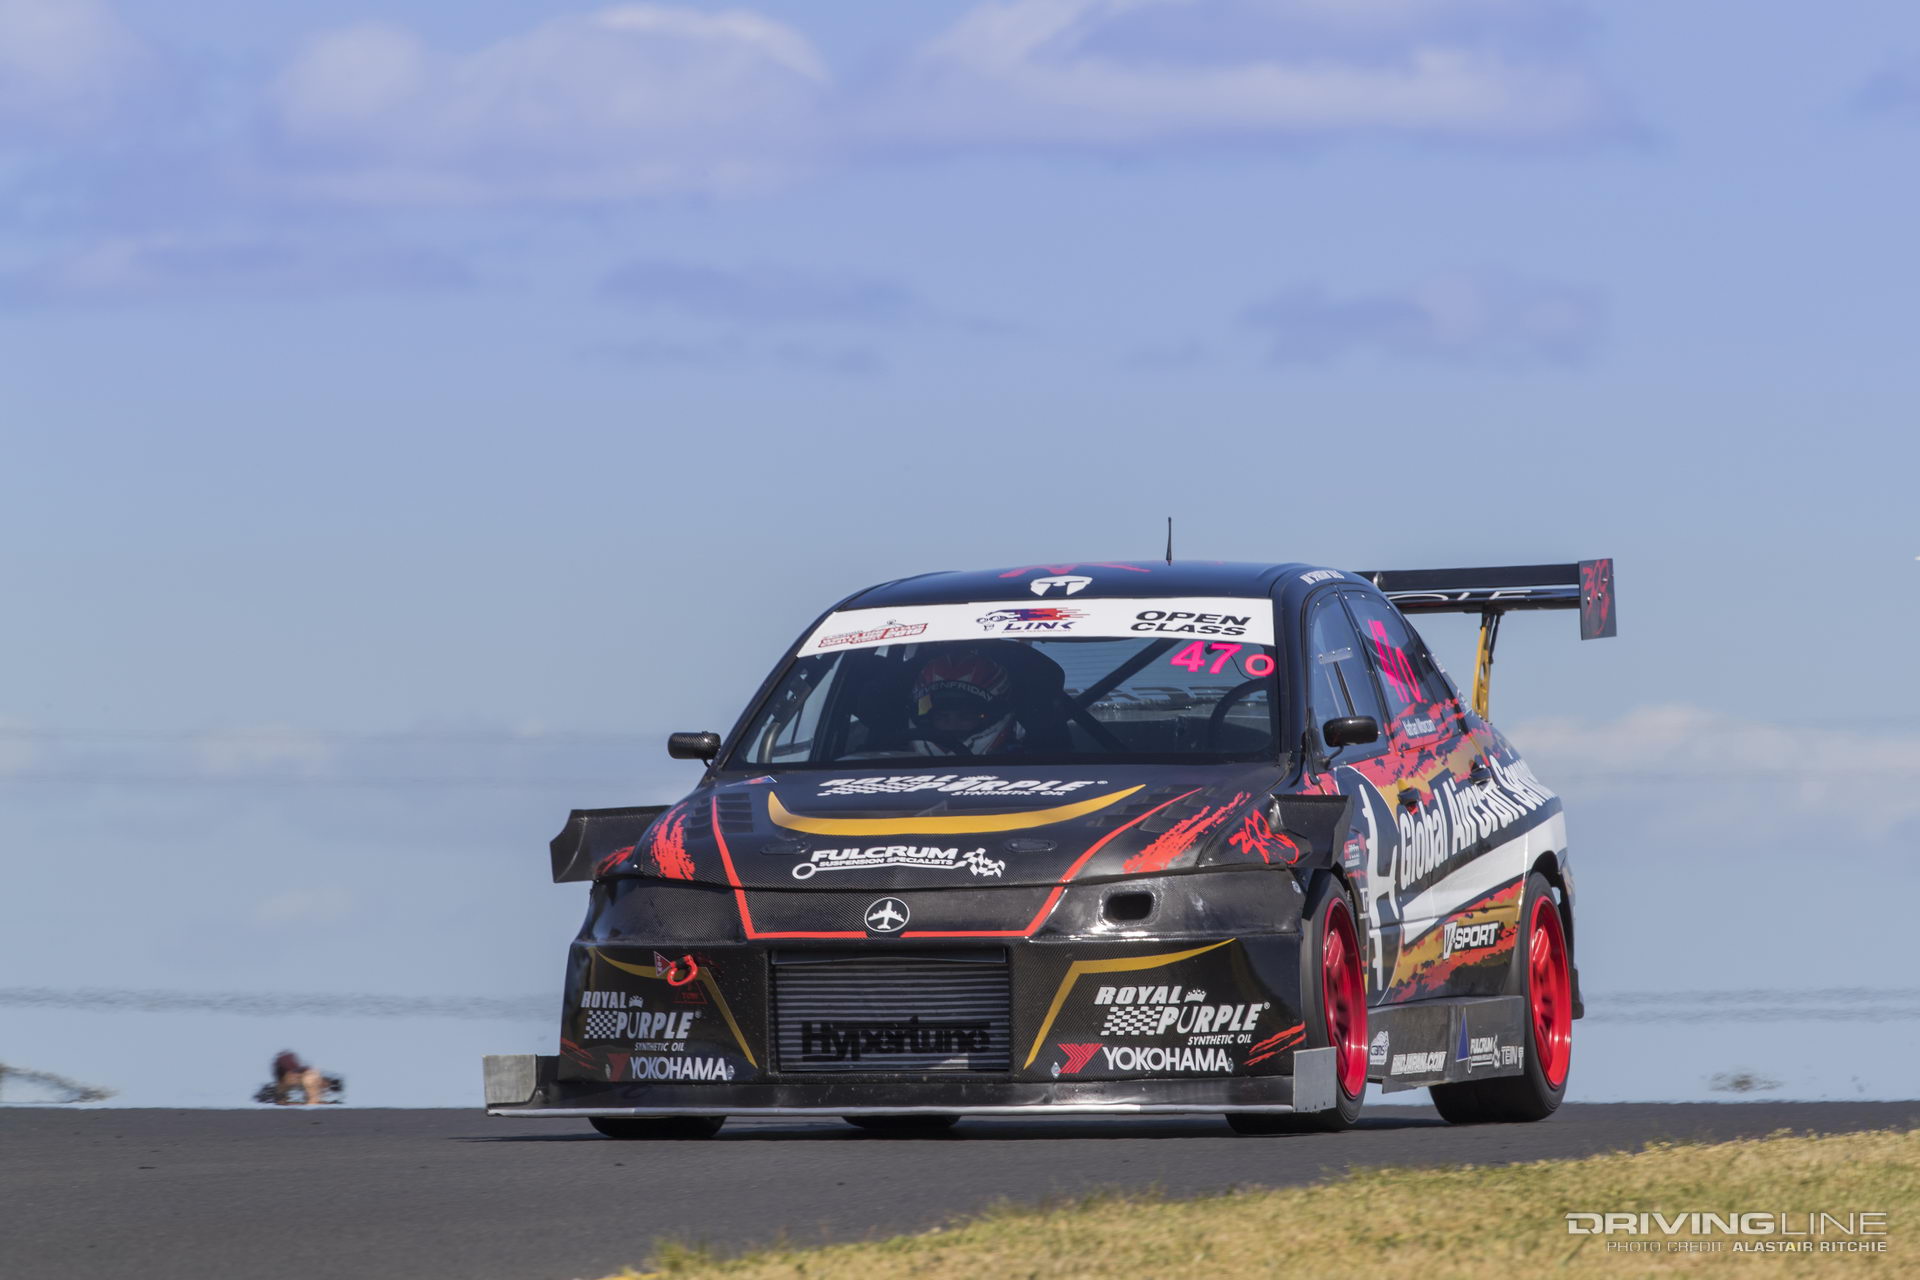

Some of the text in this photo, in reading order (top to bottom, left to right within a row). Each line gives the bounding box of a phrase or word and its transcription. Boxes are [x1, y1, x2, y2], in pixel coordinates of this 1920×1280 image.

[1004, 621, 1076, 631] LINK
[1136, 611, 1251, 626] OPEN
[1131, 622, 1246, 636] CLASS
[1170, 640, 1243, 675] 47
[819, 775, 958, 787] ROYAL
[903, 780, 1095, 793] PURPLE
[1399, 788, 1449, 891] Global
[810, 845, 959, 863] FULCRUM
[819, 856, 953, 867] SUSPENSION SPECIALISTS
[580, 991, 627, 1009] ROYAL
[1093, 985, 1183, 1006] ROYAL
[615, 1011, 695, 1039] PURPLE
[1155, 1003, 1264, 1035] PURPLE
[634, 1042, 685, 1052] SYNTHETIC OIL
[802, 1016, 991, 1062] Hypertune
[1187, 1033, 1252, 1046] SYNTHETIC OIL
[1102, 1046, 1229, 1072] YOKOHAMA
[630, 1056, 728, 1081] YOKOHAMA
